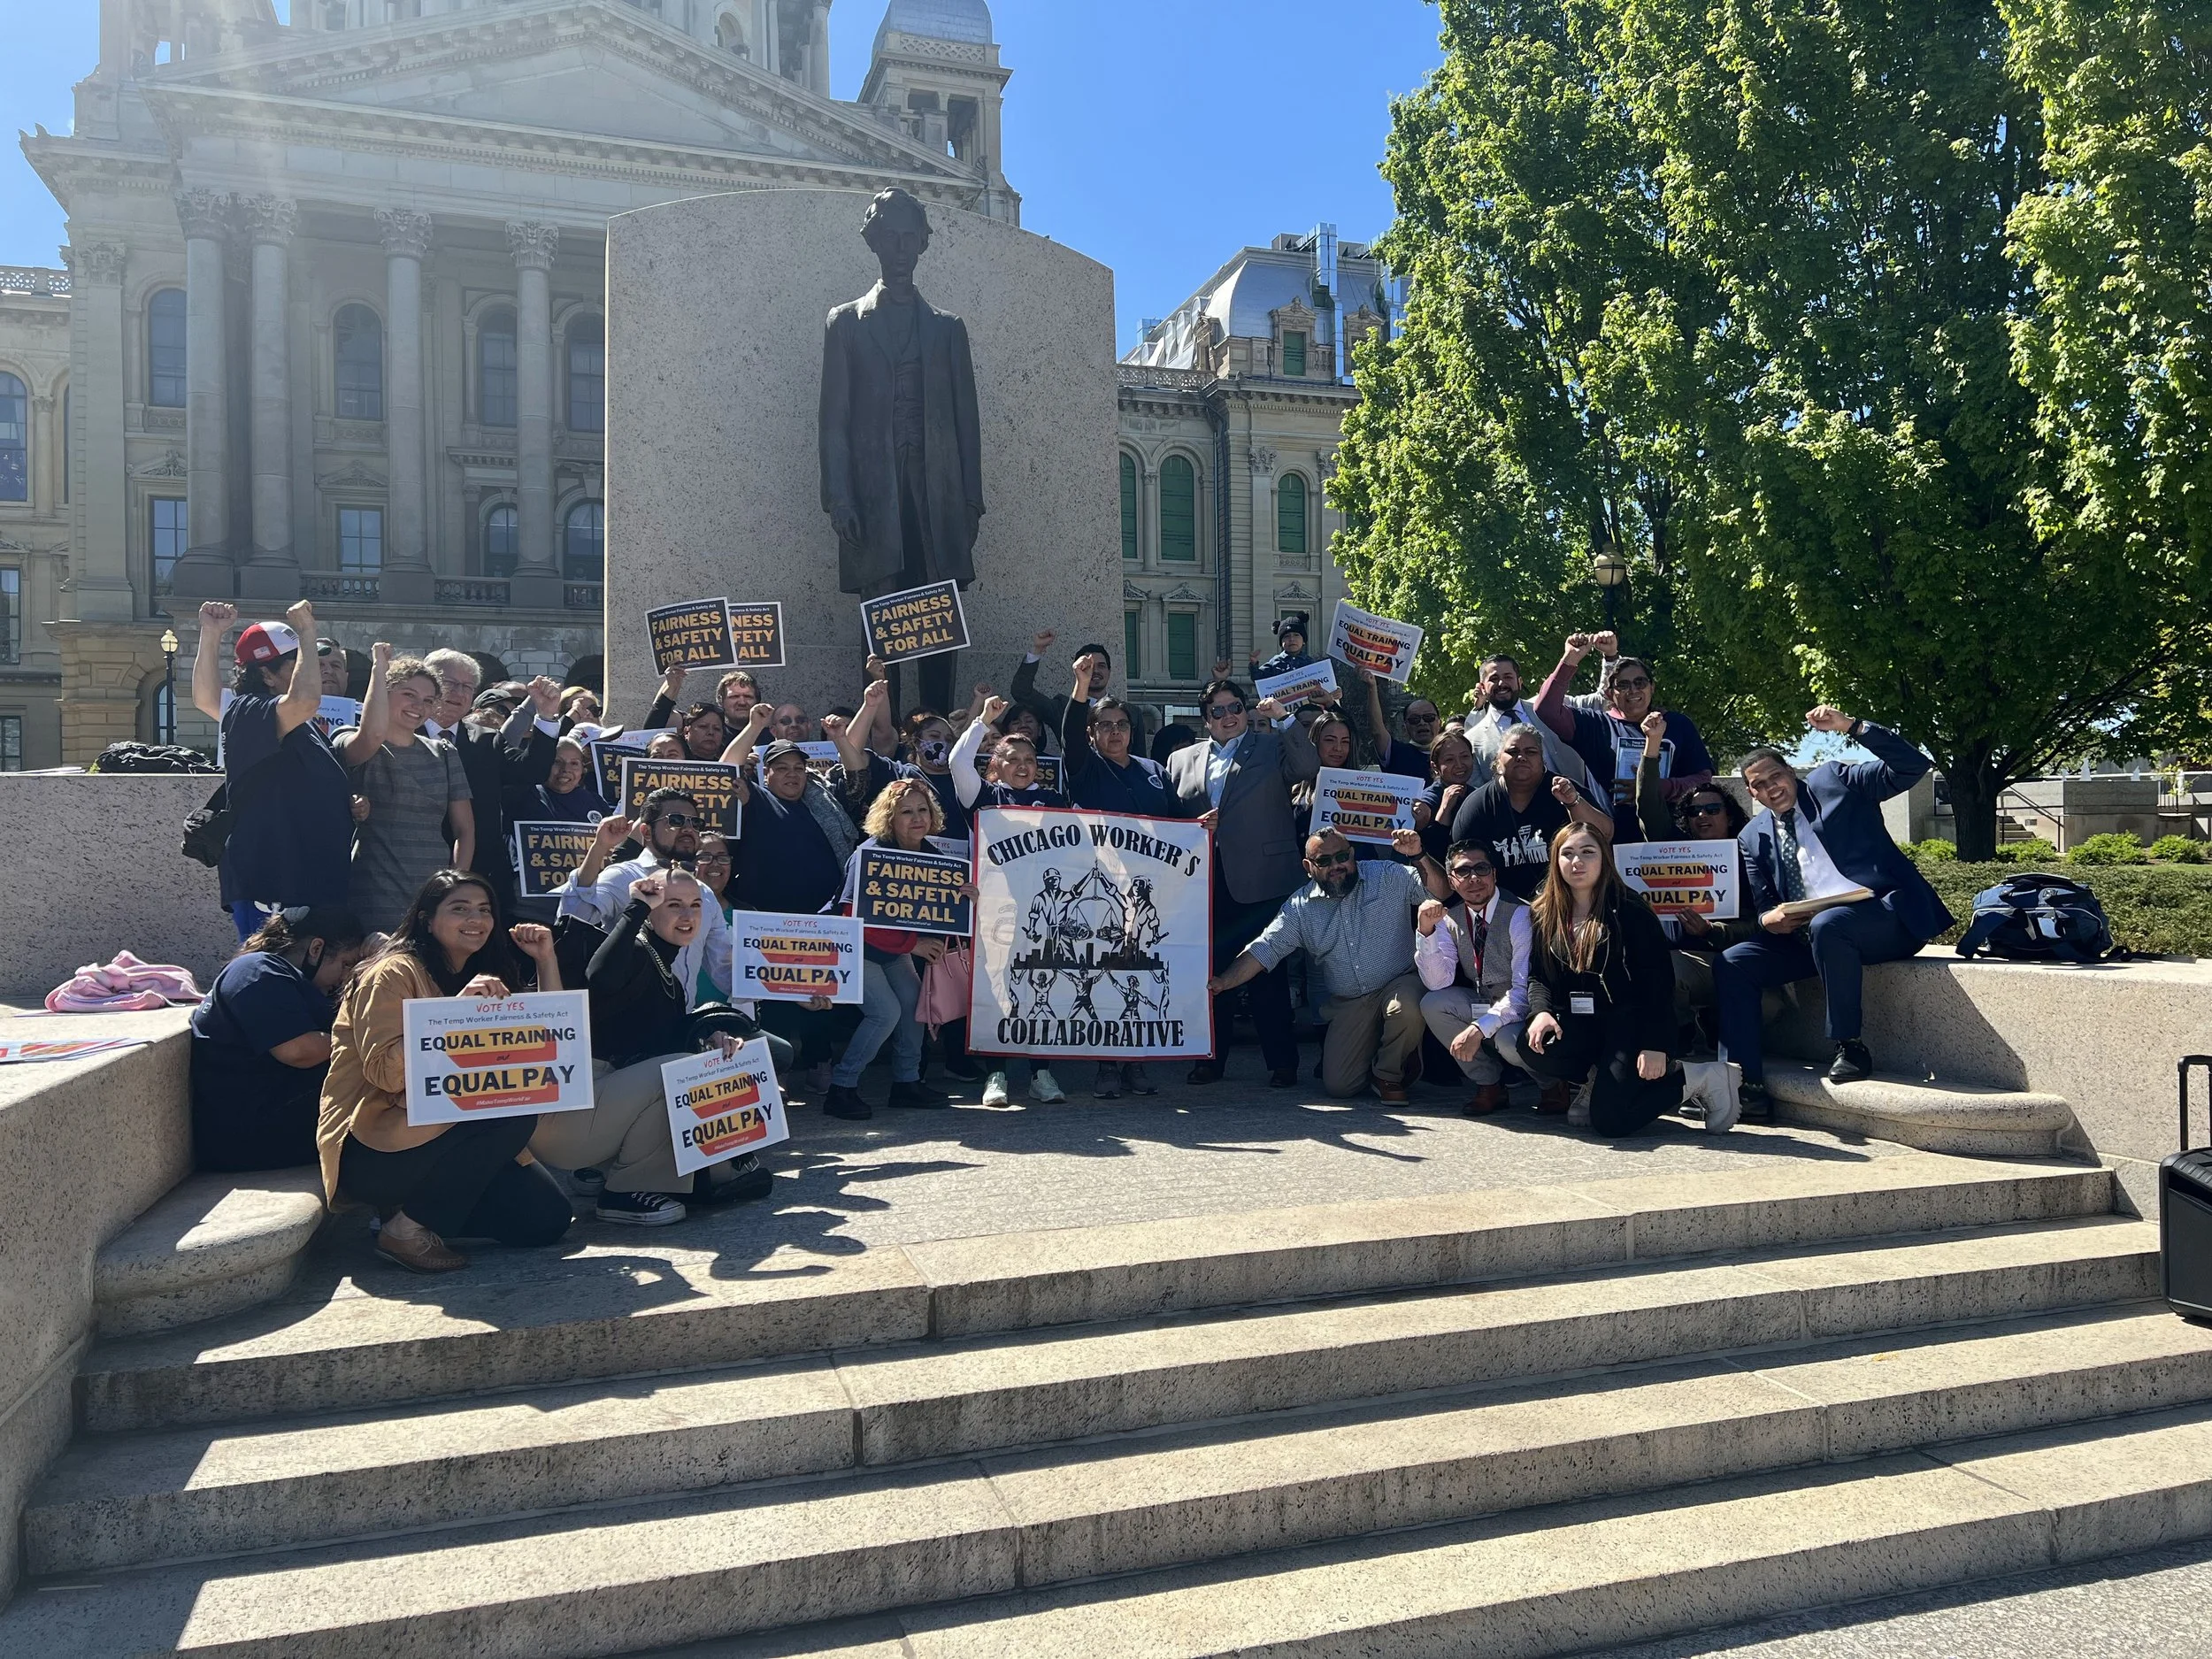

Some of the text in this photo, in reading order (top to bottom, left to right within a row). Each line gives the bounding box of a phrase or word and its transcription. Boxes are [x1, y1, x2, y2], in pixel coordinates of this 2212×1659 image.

[871, 594, 951, 625] FAIRNESS
[652, 611, 722, 634] FAIRNESS
[731, 614, 774, 627] NESS
[875, 609, 954, 640] & SAFETY
[655, 627, 723, 650] & SAFETY
[733, 629, 774, 643] FETY
[884, 635, 918, 655] FOR
[922, 628, 954, 647] ALL
[1339, 620, 1410, 649] EQUAL TRAINING
[660, 645, 721, 666] FOR ALL
[738, 646, 770, 659] ALL
[1335, 637, 1404, 669] EQUAL PAY
[1292, 677, 1329, 692] TRAINING
[312, 717, 343, 726] NING
[634, 772, 733, 791] FAIRNESS
[633, 792, 645, 806] &
[693, 794, 732, 809] ETY
[1323, 788, 1410, 805] EQUAL TRAINING
[1321, 810, 1407, 829] EQUAL PAY
[987, 824, 1081, 866] CHICAGO
[531, 853, 546, 867] &
[540, 872, 567, 886] FO
[867, 861, 964, 887] FAIRNESS
[1625, 864, 1728, 877] EQUAL TRAINING
[865, 881, 963, 905] & SAFETY
[1640, 889, 1726, 903] QUAL PAY
[872, 901, 956, 923] FOR ALL
[743, 938, 853, 953] EQUAL TRAINING
[744, 965, 851, 984] EQUAL PAY
[476, 1002, 525, 1013] VOTE YES
[465, 1015, 494, 1024] Worker
[533, 1011, 556, 1020] Safety
[420, 1027, 576, 1052] EQUAL TRAINING
[997, 1018, 1185, 1048] COLLABORATIVE
[699, 1070, 716, 1079] Worker
[717, 1064, 734, 1073] Fairness
[739, 1059, 752, 1068] Safety
[703, 1057, 720, 1069] VOTE
[425, 1064, 575, 1097] EQUAL PAY
[674, 1071, 767, 1109] EQUAL TRAINING
[681, 1116, 739, 1148] EQUAL
[740, 1103, 772, 1129] PAY
